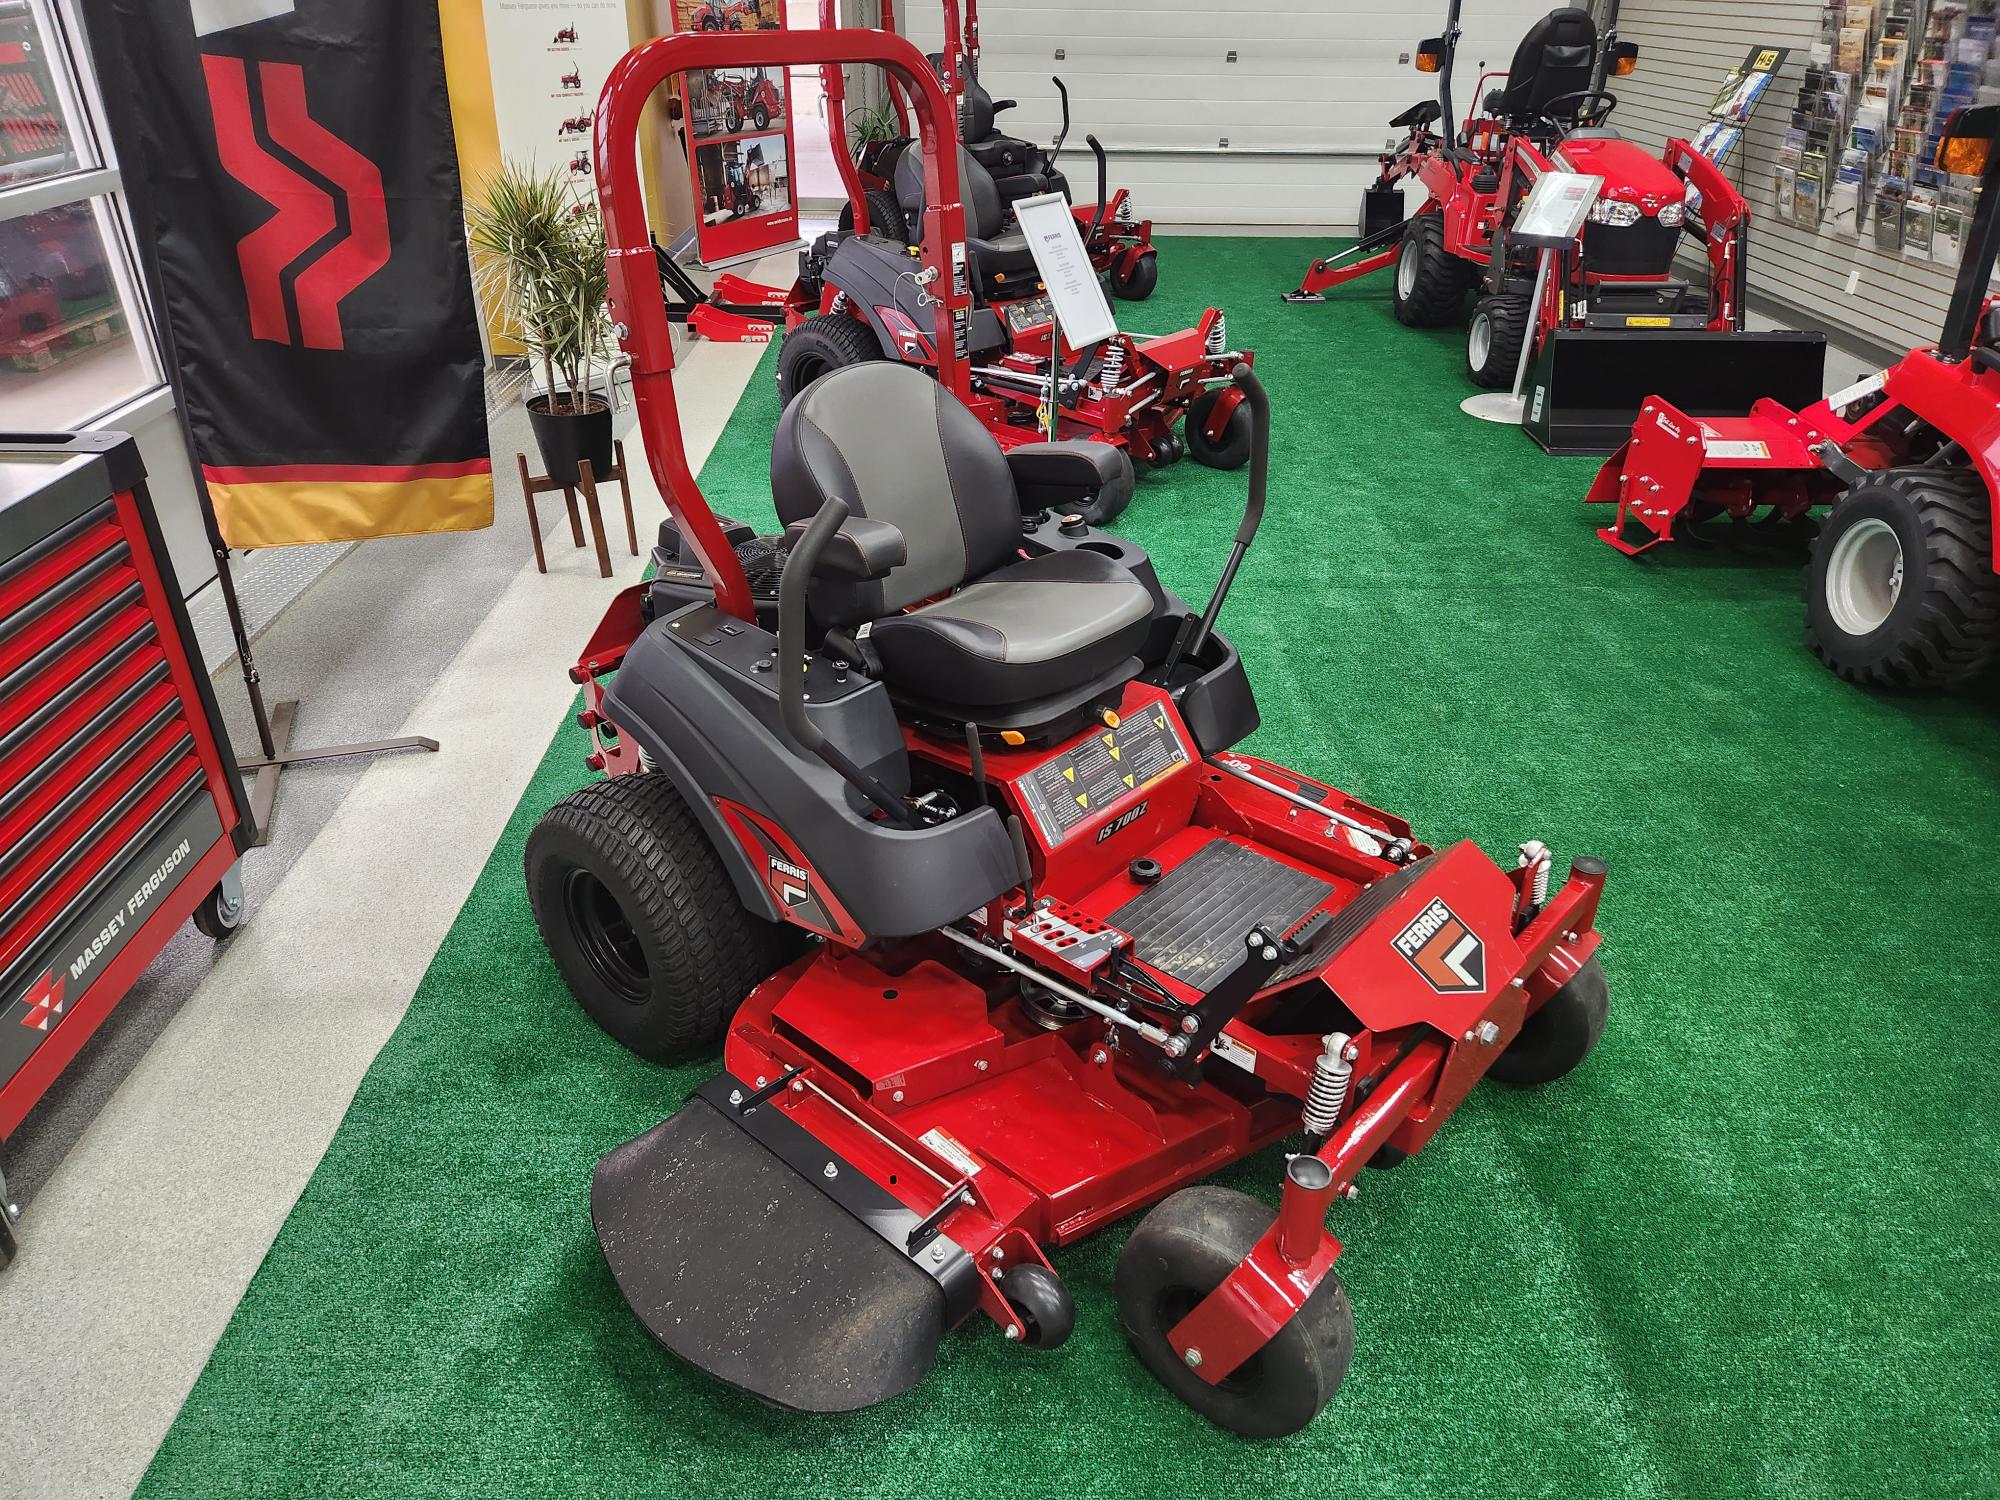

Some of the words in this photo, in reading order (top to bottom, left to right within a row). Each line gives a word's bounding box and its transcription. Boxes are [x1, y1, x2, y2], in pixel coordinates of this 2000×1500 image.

[1098, 822, 1115, 841] IS
[1114, 801, 1149, 831] 700Z
[771, 858, 808, 881] FERRIS
[69, 909, 126, 980] MASSEY
[126, 838, 191, 916] FERGUSON
[1396, 902, 1450, 957] FERRIS
